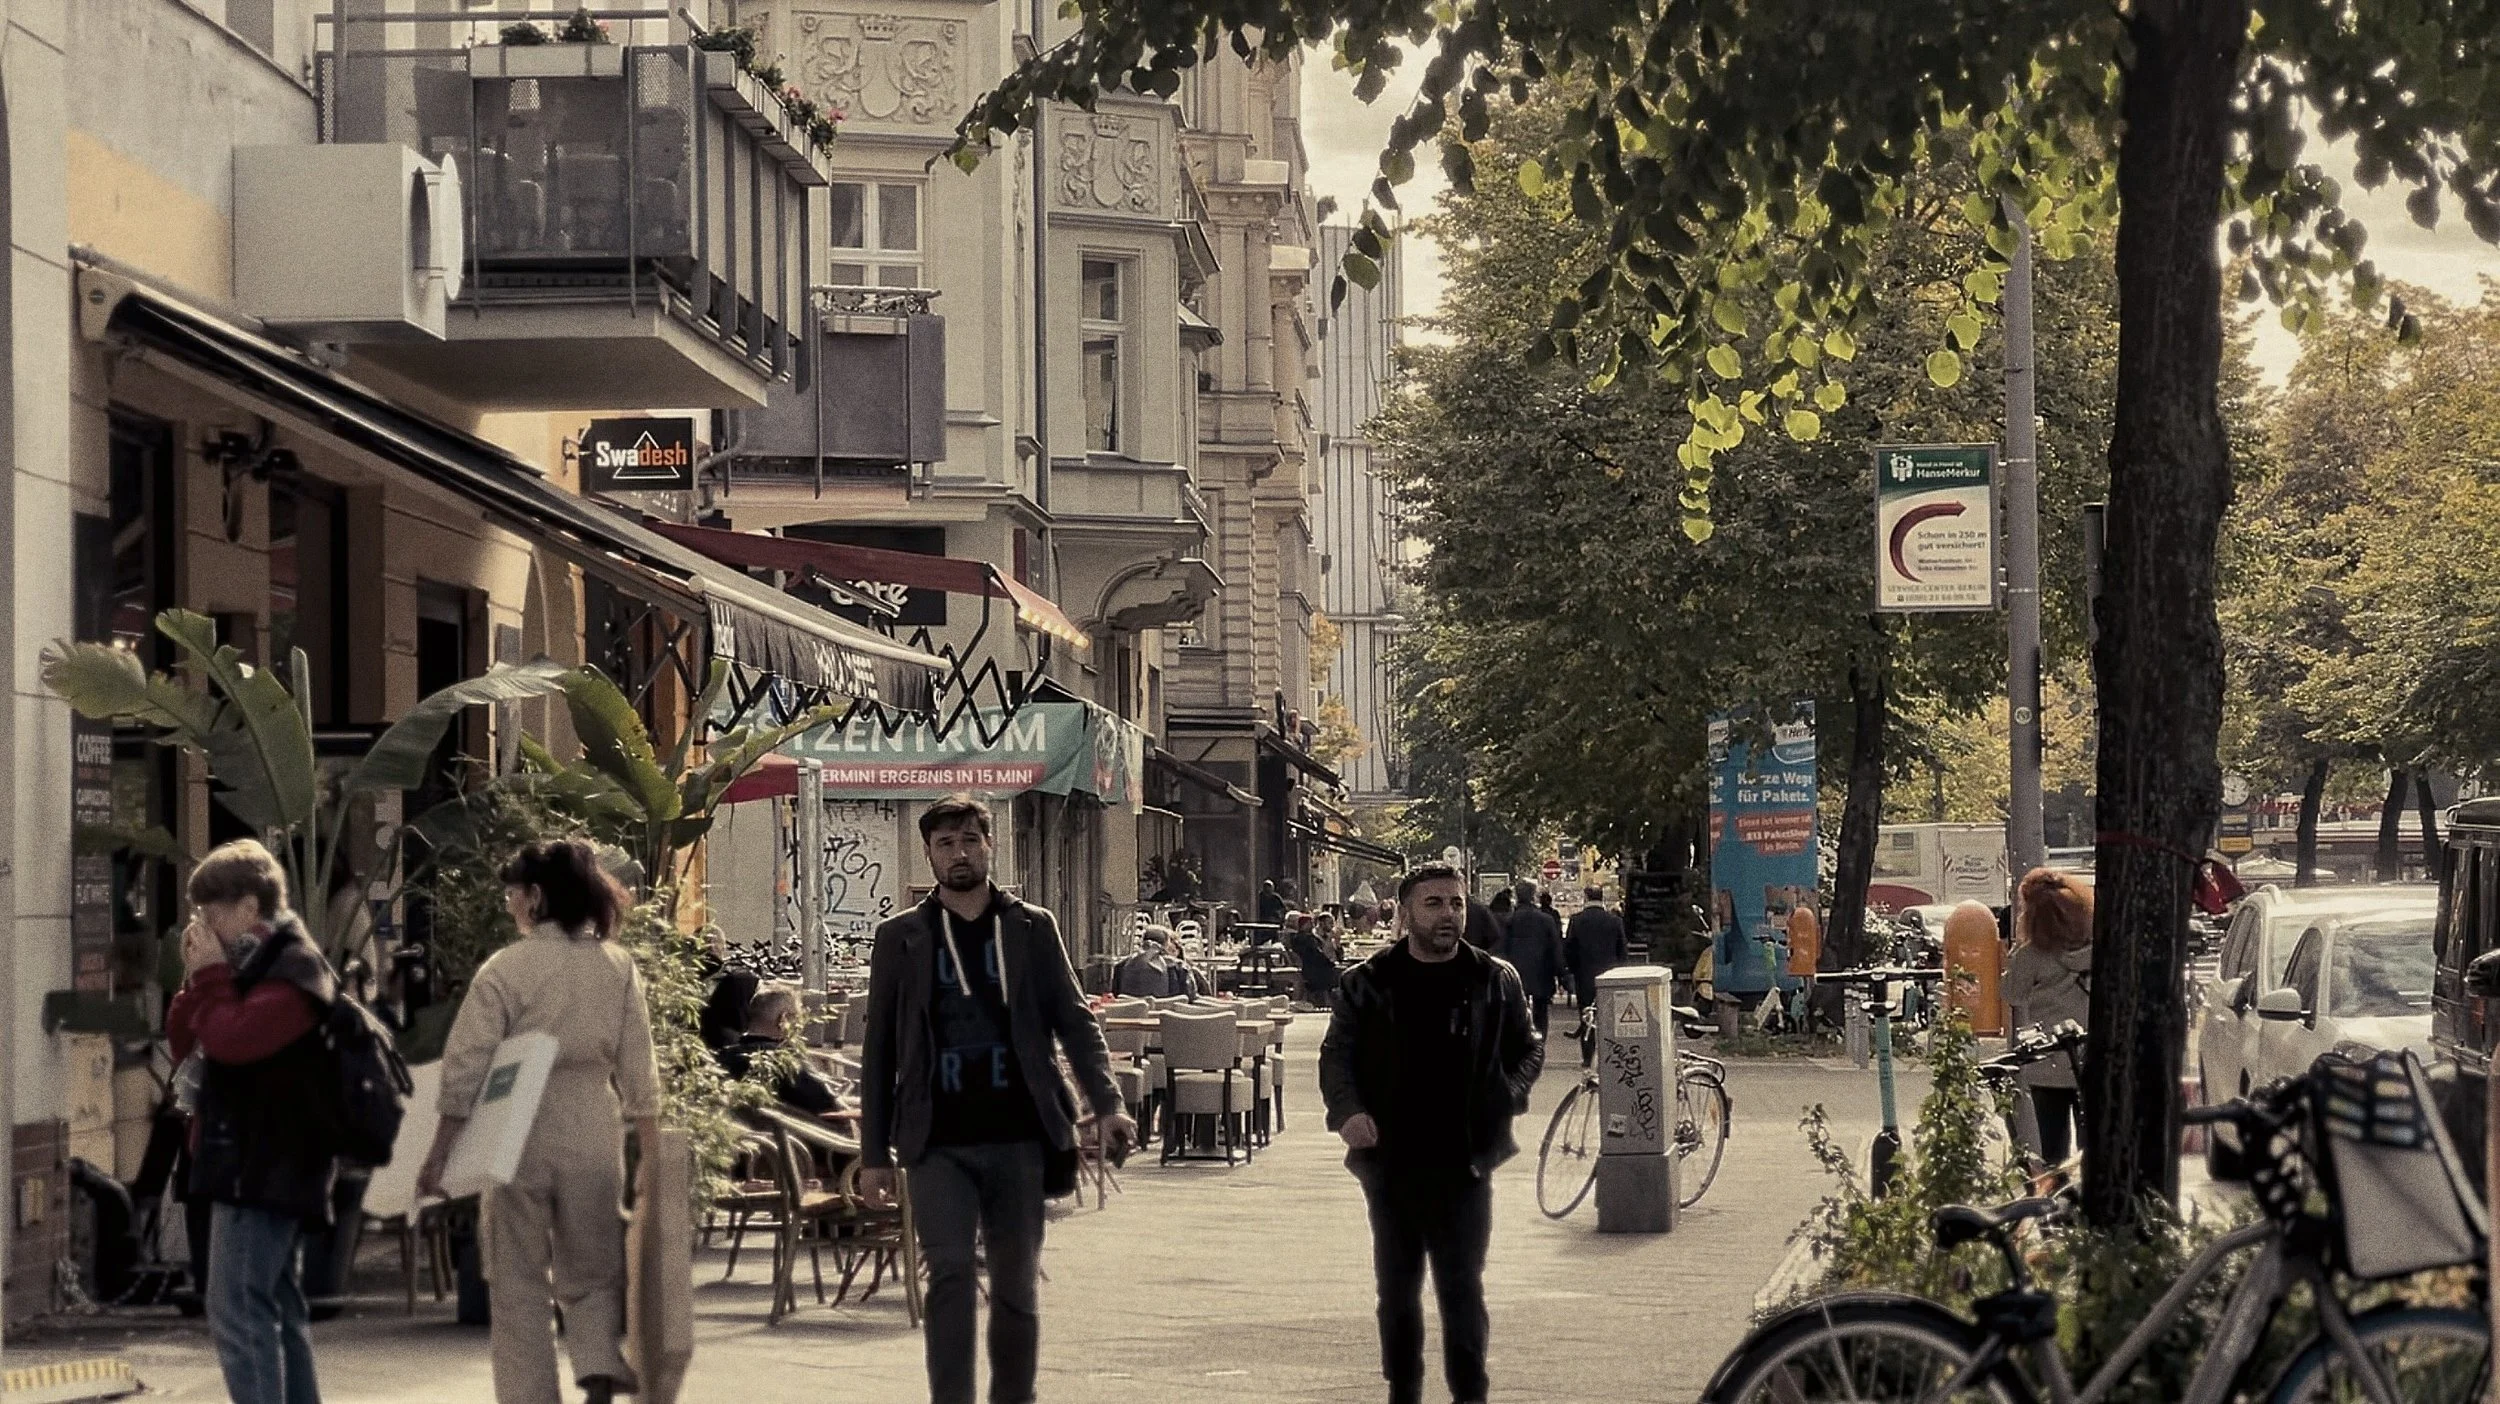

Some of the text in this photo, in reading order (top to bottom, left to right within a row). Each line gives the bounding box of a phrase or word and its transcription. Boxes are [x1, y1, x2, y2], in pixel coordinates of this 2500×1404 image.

[596, 441, 687, 467] Swadesh
[1916, 467, 1981, 478] HanseMerkur
[821, 768, 1033, 784] ERMIN! ERGEBNIS IN 15 MIN!
[1737, 772, 1780, 785] Kze
[1737, 789, 1758, 802] für
